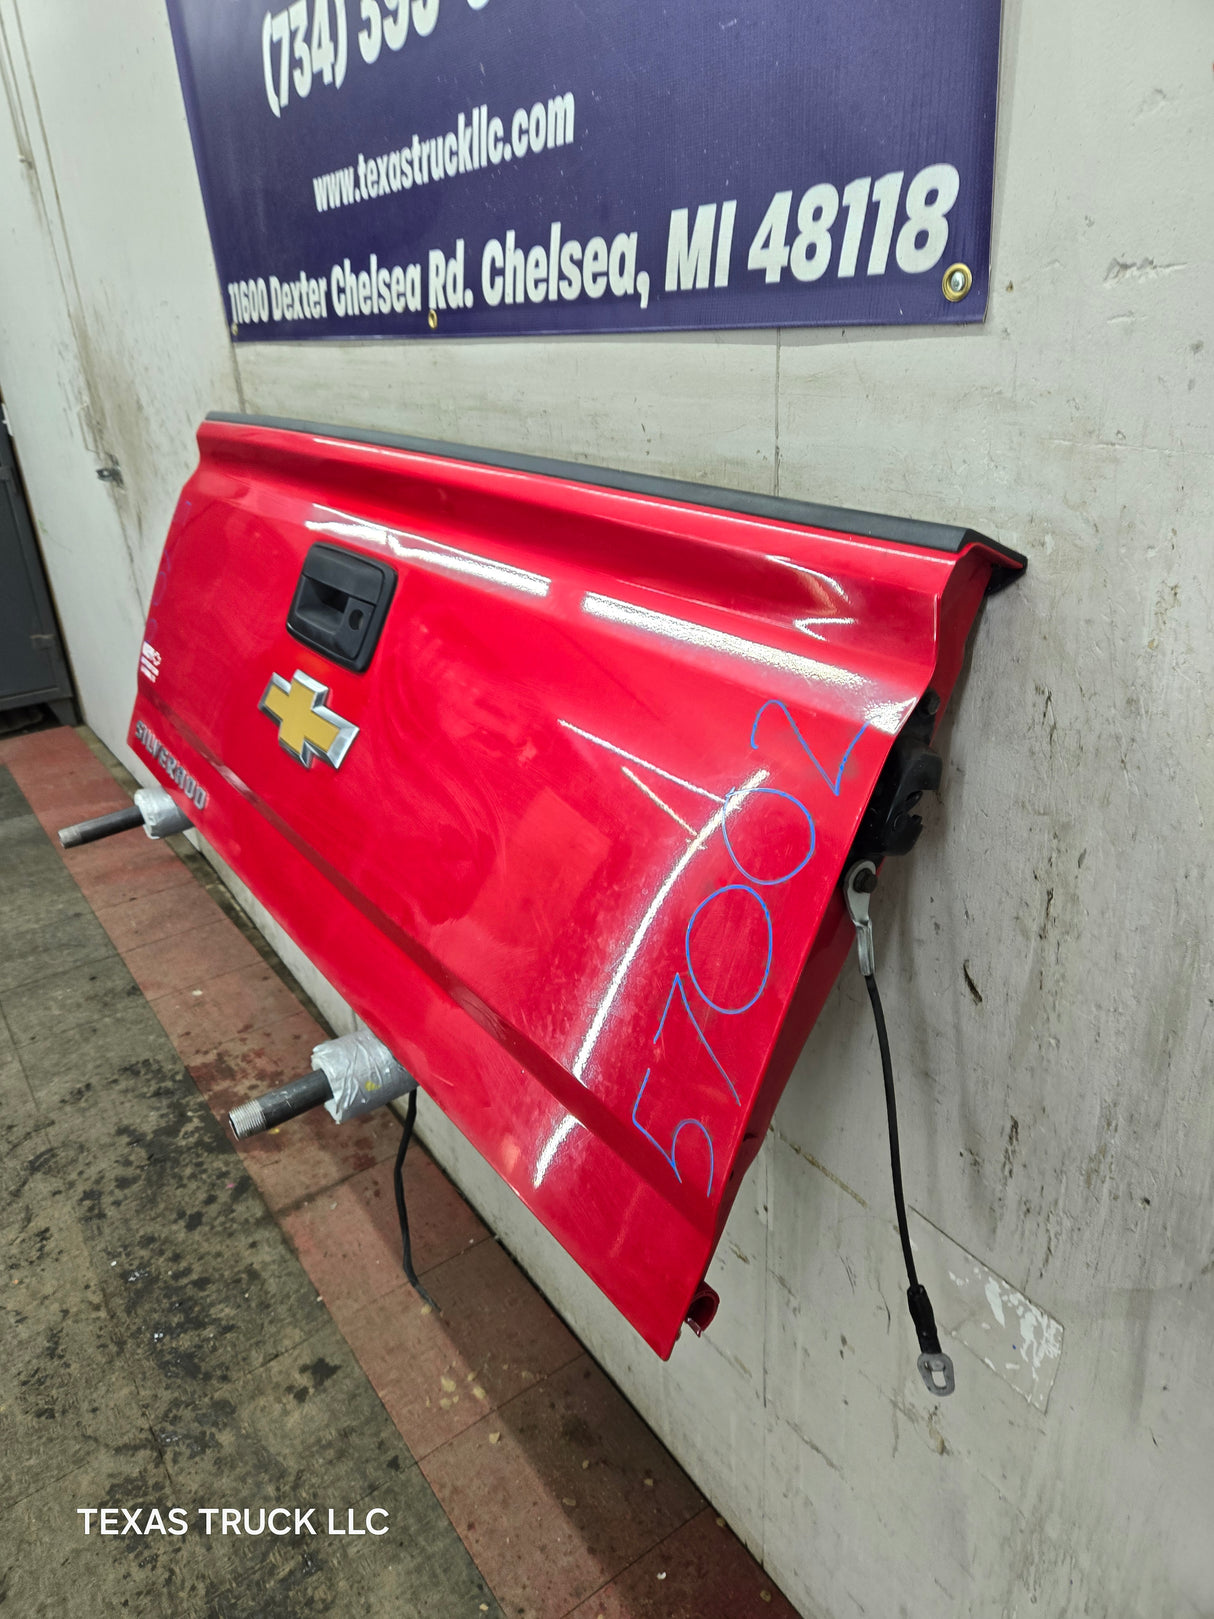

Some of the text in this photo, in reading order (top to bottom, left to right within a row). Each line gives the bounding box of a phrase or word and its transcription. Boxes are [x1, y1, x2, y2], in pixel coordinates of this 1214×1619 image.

[262, 0, 347, 118] (734)
[313, 92, 575, 212] www.texastruckllc.com
[228, 163, 960, 324] 11600 Dexter Chelsea Rd. Chelsea, MI 48118
[135, 720, 209, 810] SILVERADO
